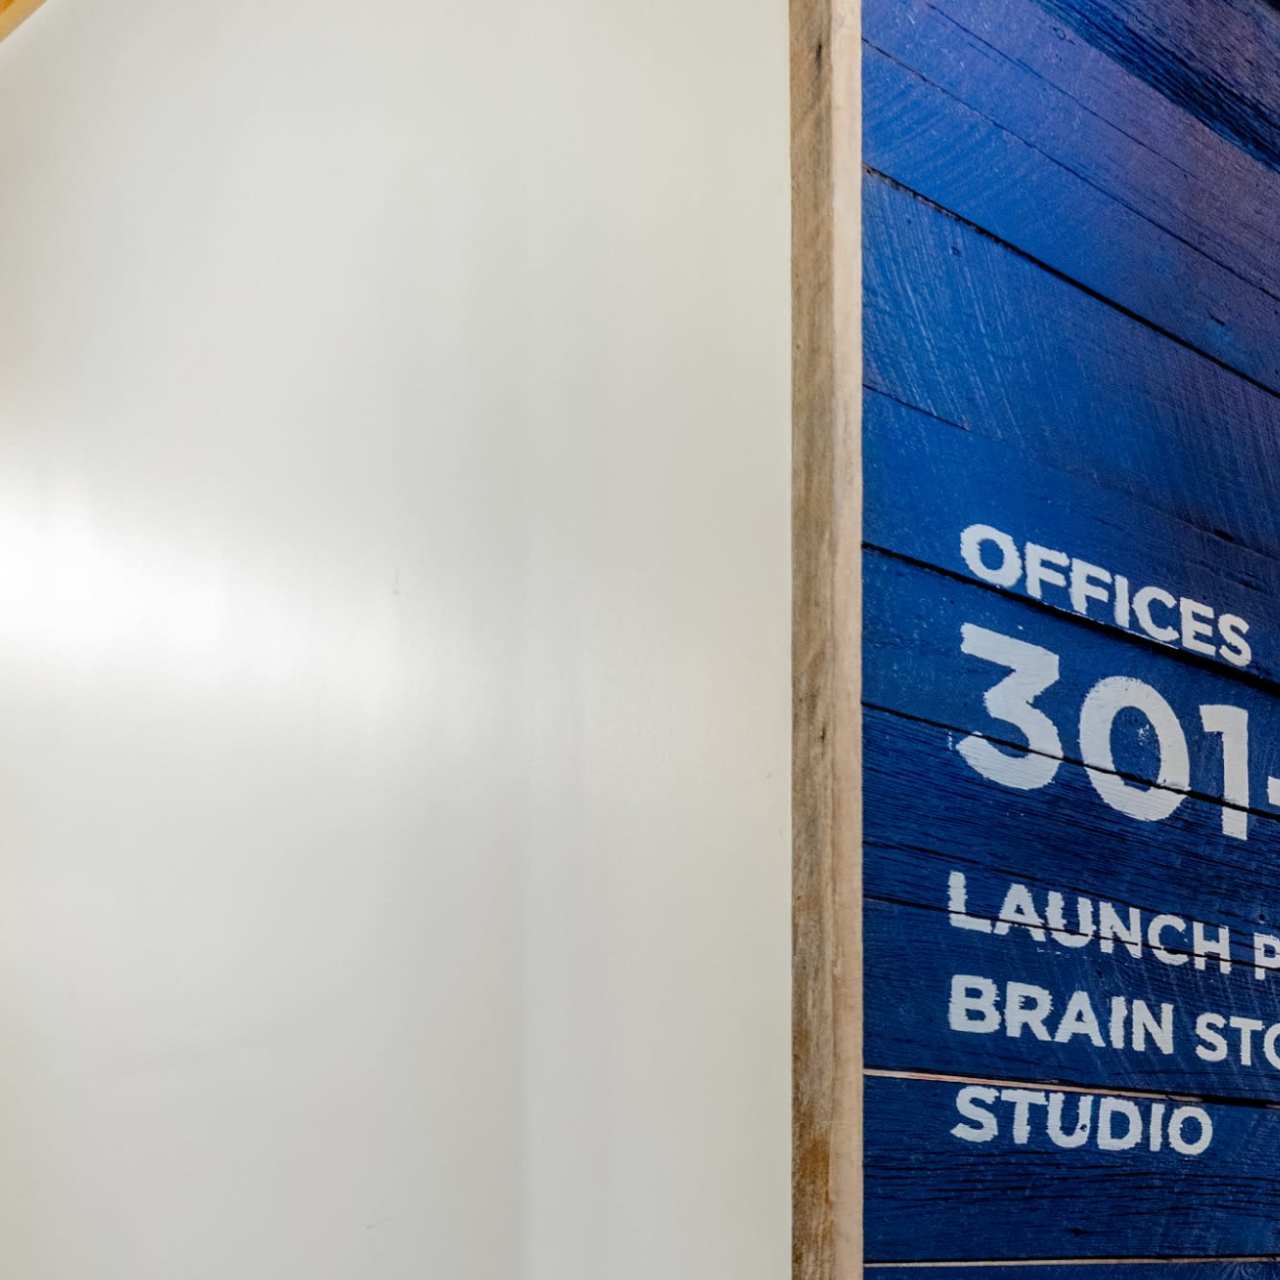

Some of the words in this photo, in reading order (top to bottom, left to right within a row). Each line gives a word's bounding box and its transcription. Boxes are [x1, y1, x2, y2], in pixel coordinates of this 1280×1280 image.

[960, 523, 1253, 667] OFFICES
[947, 871, 1232, 975] LAUNCH
[948, 975, 1175, 1056] BRAIN
[950, 1087, 1213, 1156] STUDIO
